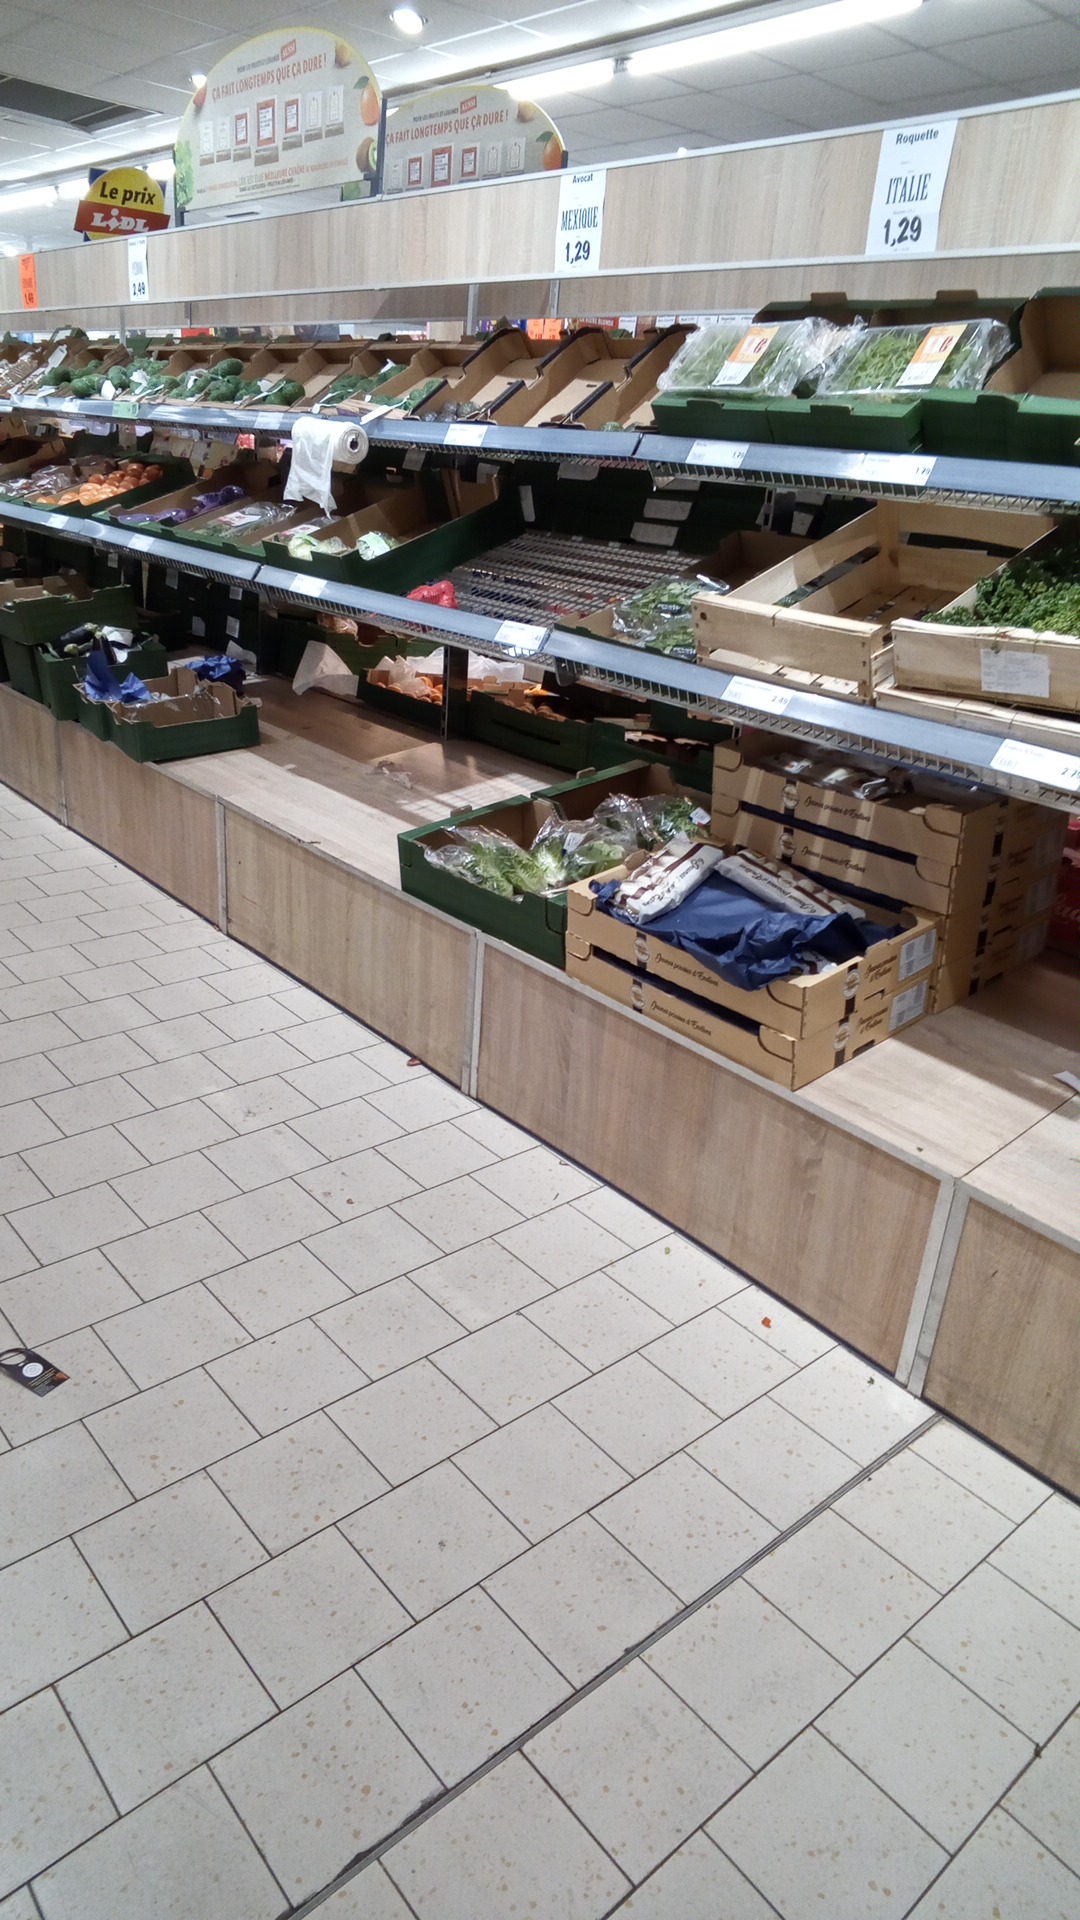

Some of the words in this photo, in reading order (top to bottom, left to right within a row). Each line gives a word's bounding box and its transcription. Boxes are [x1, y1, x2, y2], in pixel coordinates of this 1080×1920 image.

[221, 83, 235, 98] FAIT
[236, 69, 275, 93] LONGTEMPS
[276, 64, 290, 84] QUE
[291, 60, 302, 79] ÇA
[303, 54, 322, 74] DURE
[395, 130, 410, 143] FAIT
[410, 120, 453, 140] LONGTEMPS
[454, 117, 469, 134] QUE
[471, 115, 481, 131] ÇA
[483, 110, 504, 126] DURE
[896, 128, 939, 145] Roquette
[572, 173, 593, 184] Avocat
[885, 172, 932, 205] ITALIE
[100, 182, 118, 200] Le
[122, 187, 156, 205] prix
[561, 206, 598, 231] MEXIQUE
[884, 215, 922, 247] 1,29
[565, 240, 591, 264] 1,29
